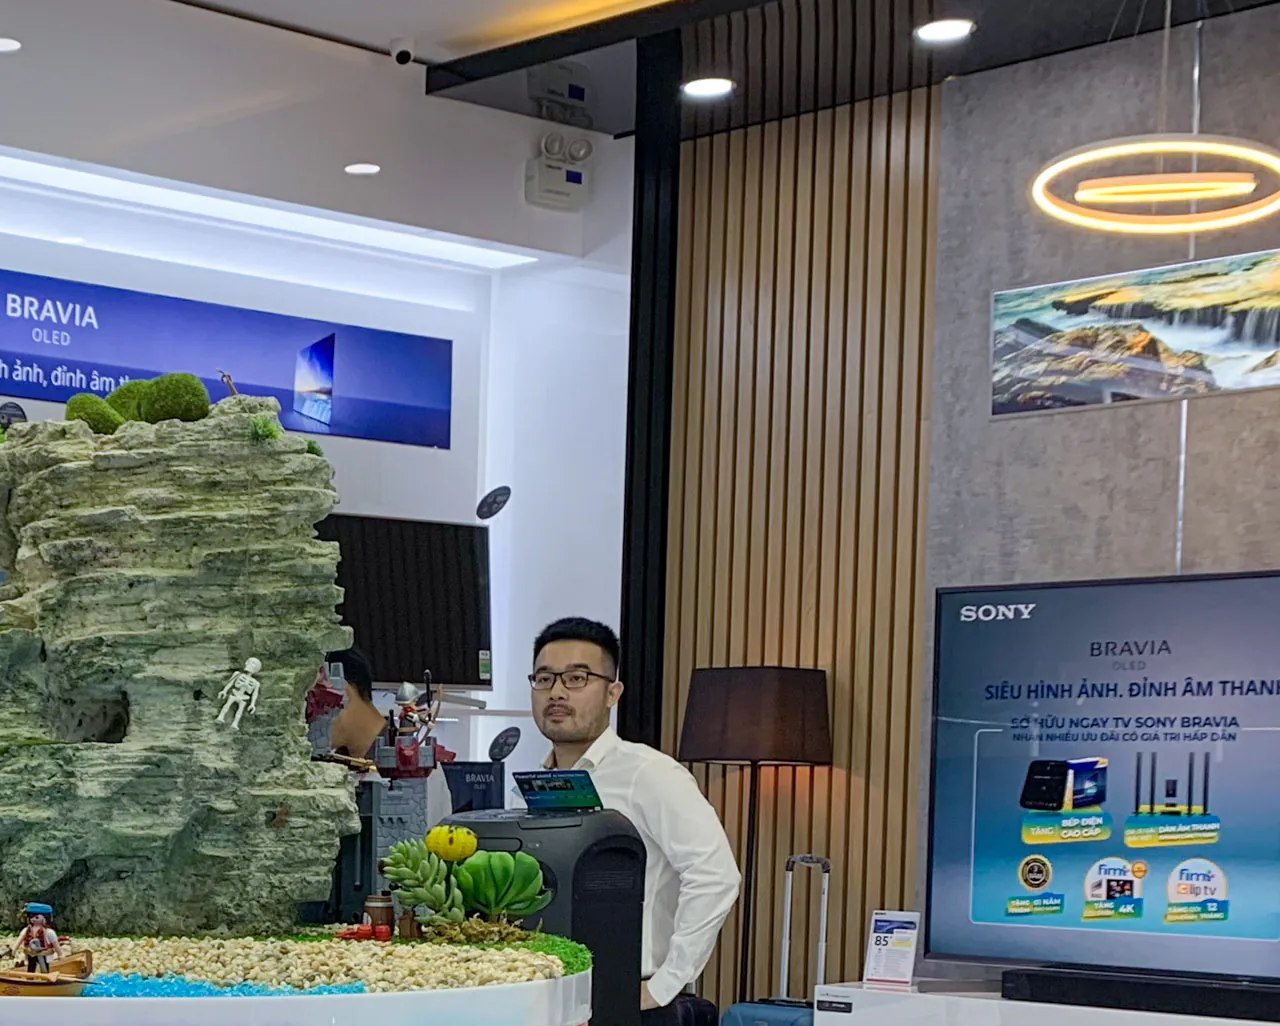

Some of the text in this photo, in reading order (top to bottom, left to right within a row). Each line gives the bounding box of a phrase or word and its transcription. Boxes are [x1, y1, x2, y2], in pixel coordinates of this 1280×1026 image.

[6, 293, 99, 329] BRAVIA
[31, 327, 71, 346] OLED
[12, 359, 48, 388] ảnh,
[51, 365, 86, 389] đỉnh
[90, 369, 115, 392] âm
[960, 604, 1036, 622] SONY
[1090, 640, 1171, 657] BRAVIA
[1112, 661, 1147, 671] OLED
[984, 680, 1022, 700] SIÊU
[1027, 679, 1072, 699] HÌNH
[1128, 677, 1177, 698] ĐỈNH
[1181, 677, 1214, 697] ÂM
[1069, 717, 1109, 730] NGAY
[1113, 717, 1132, 728] TV
[1136, 716, 1175, 728] SONY
[1181, 716, 1240, 728] BRAVIA
[465, 774, 495, 783] BRAVIA
